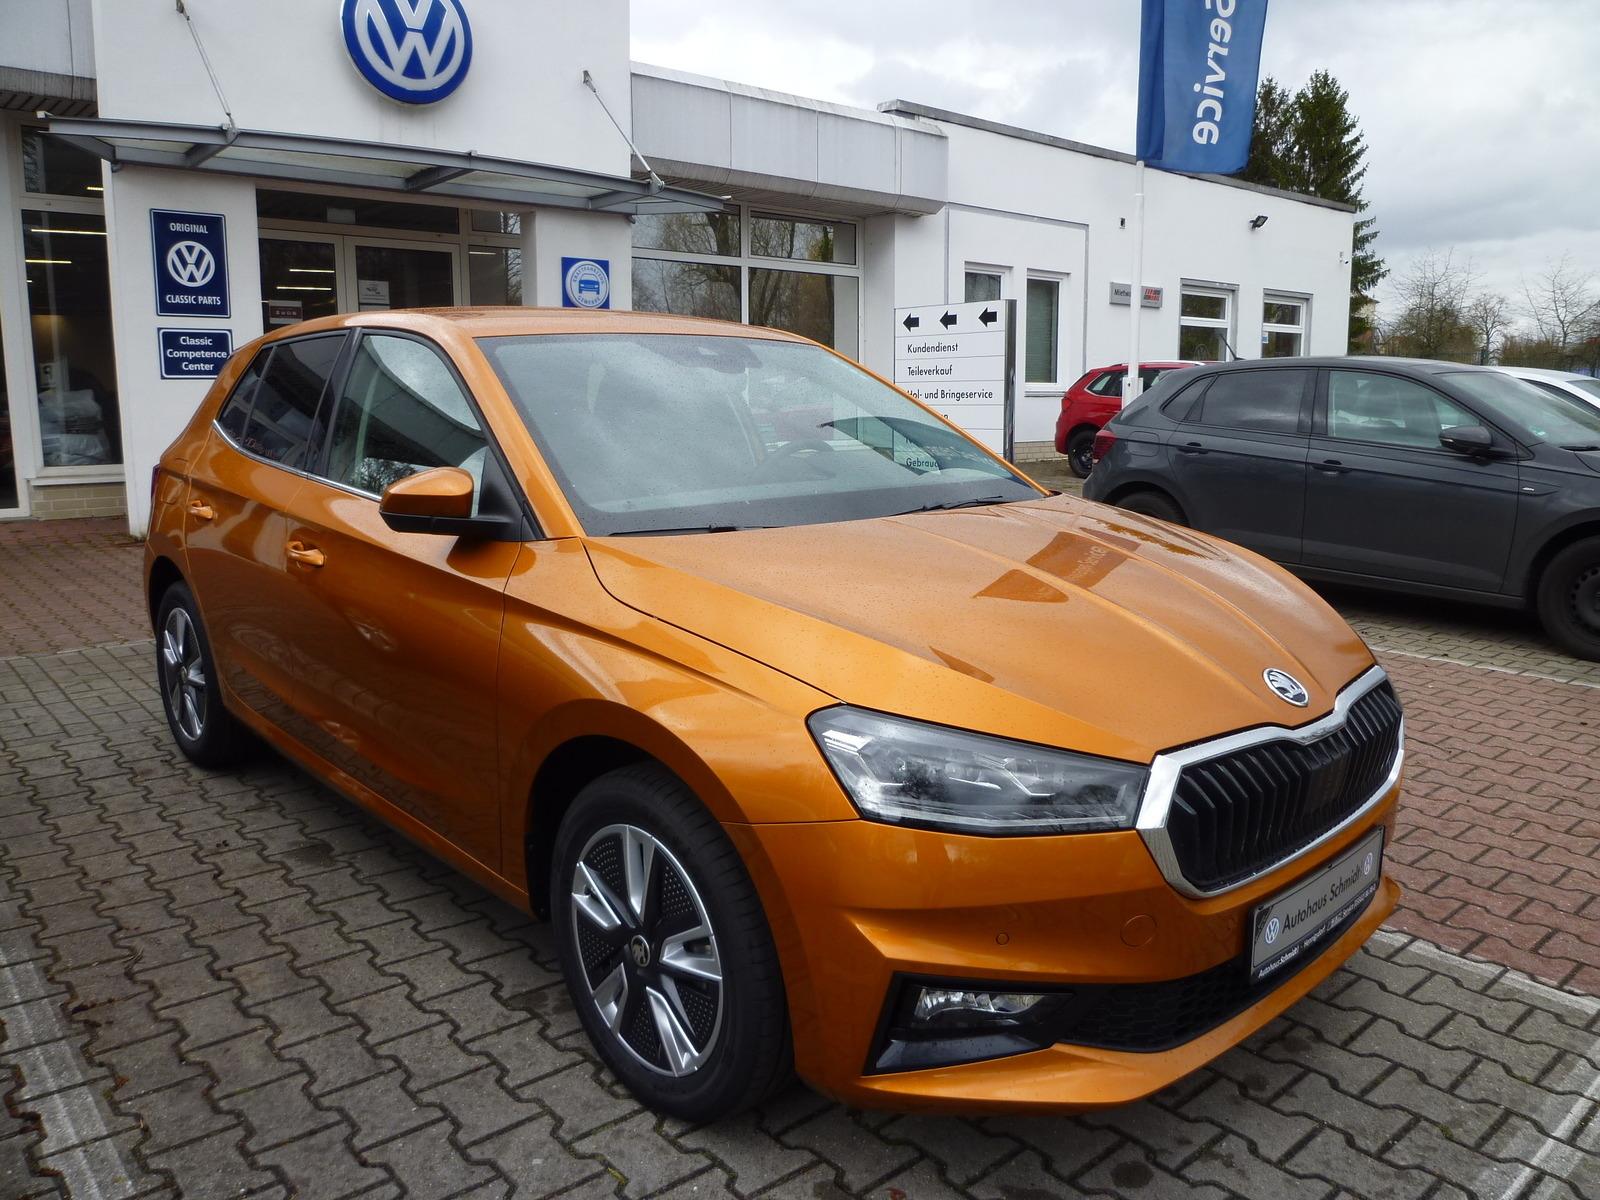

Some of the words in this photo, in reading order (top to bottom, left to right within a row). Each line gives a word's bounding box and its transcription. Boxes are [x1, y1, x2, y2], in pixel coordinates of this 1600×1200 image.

[170, 222, 208, 234] ORIGINAL
[166, 294, 196, 305] CLASSIC
[198, 296, 221, 306] PARTS
[180, 336, 213, 346] Classic
[907, 342, 958, 353] Kundendienst
[167, 349, 227, 360] Competence
[182, 361, 214, 371] Center
[907, 365, 953, 376] Teileverkauf
[924, 389, 939, 400] und
[940, 388, 993, 402] Bringeservice
[906, 457, 939, 468] Gebrauc
[1282, 894, 1327, 934] Autohaus
